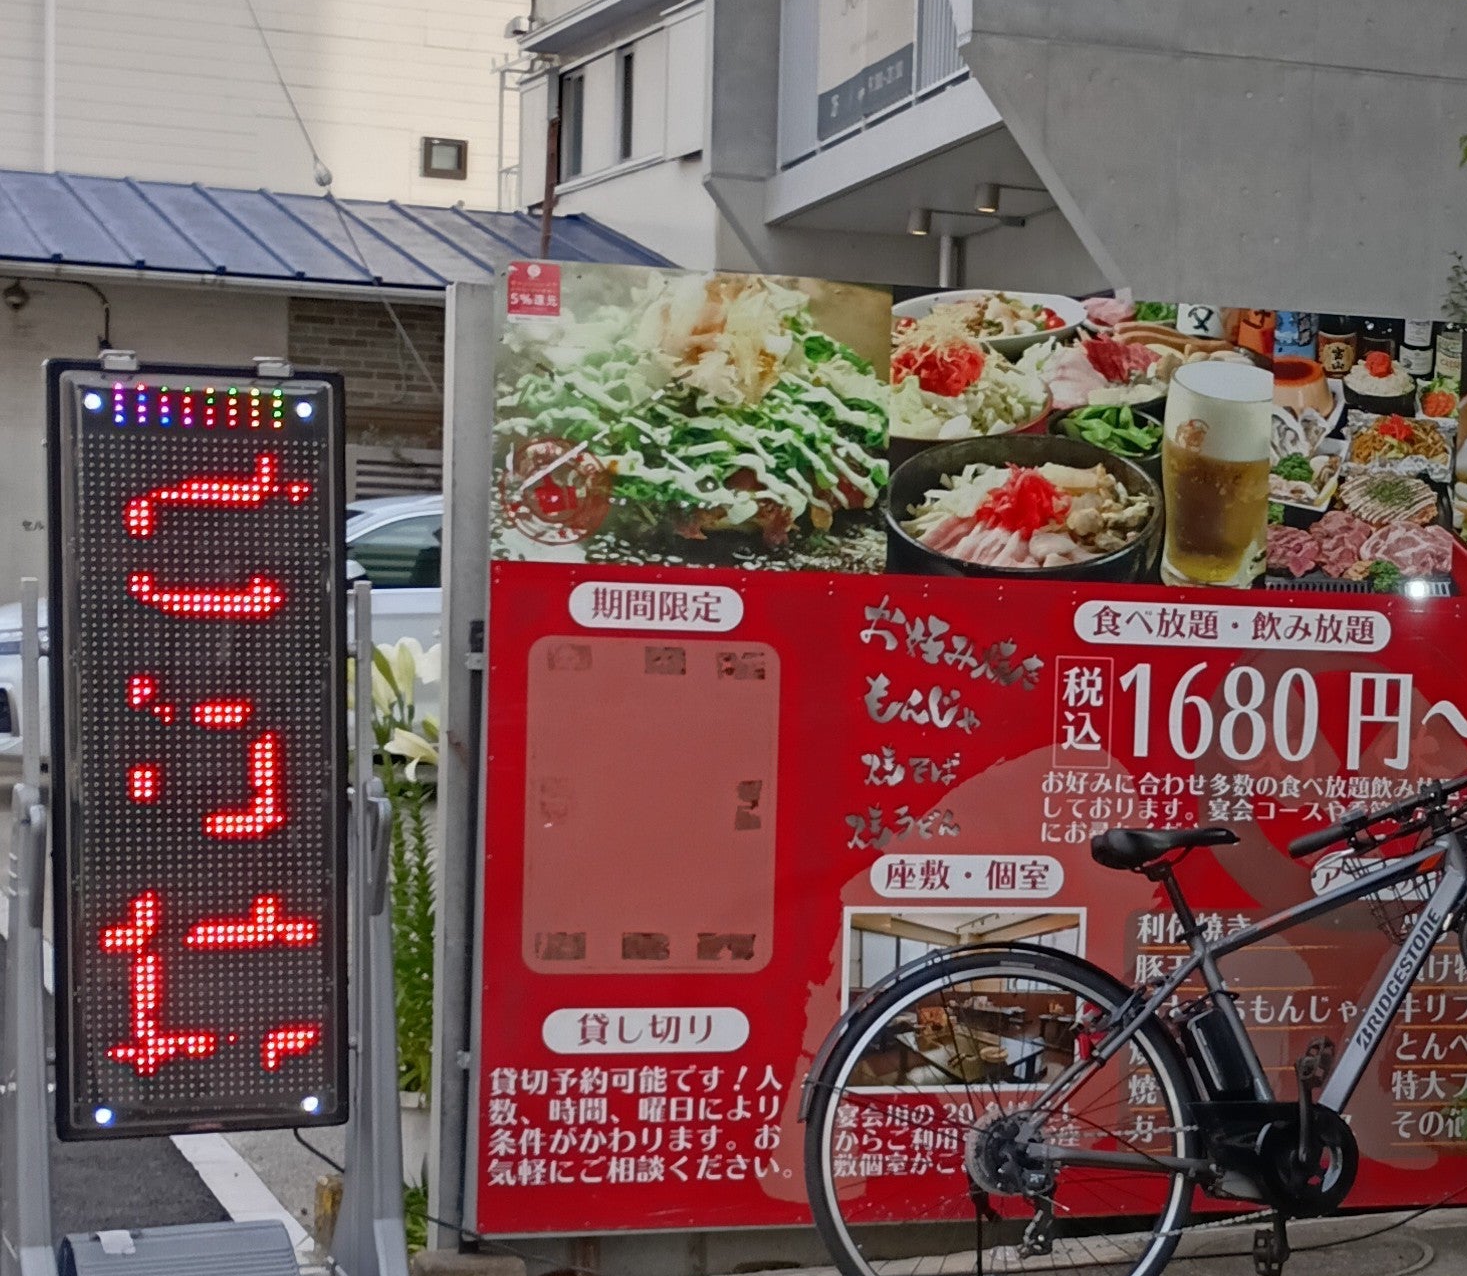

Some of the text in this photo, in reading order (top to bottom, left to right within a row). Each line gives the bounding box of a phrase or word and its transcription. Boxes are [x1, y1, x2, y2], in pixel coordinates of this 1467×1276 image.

[590, 587, 723, 626] 期間限定
[1091, 603, 1377, 647] 食べ放題・飲み放題
[860, 595, 1046, 691] お好み焼き
[864, 673, 983, 736] もんじゃ
[1061, 666, 1104, 752] 税込
[861, 743, 962, 788] 焼そば
[844, 803, 962, 850] 焼うどん
[885, 858, 1051, 892] 座敷・個室
[1355, 909, 1442, 1052] BRIDGESTONE
[576, 1011, 715, 1047] 貸し切り
[488, 1095, 782, 1126] 数、時間、曜日により
[487, 1126, 782, 1157] 条件がかわります。お
[486, 1154, 795, 1187] 気軽にご相談ください。
